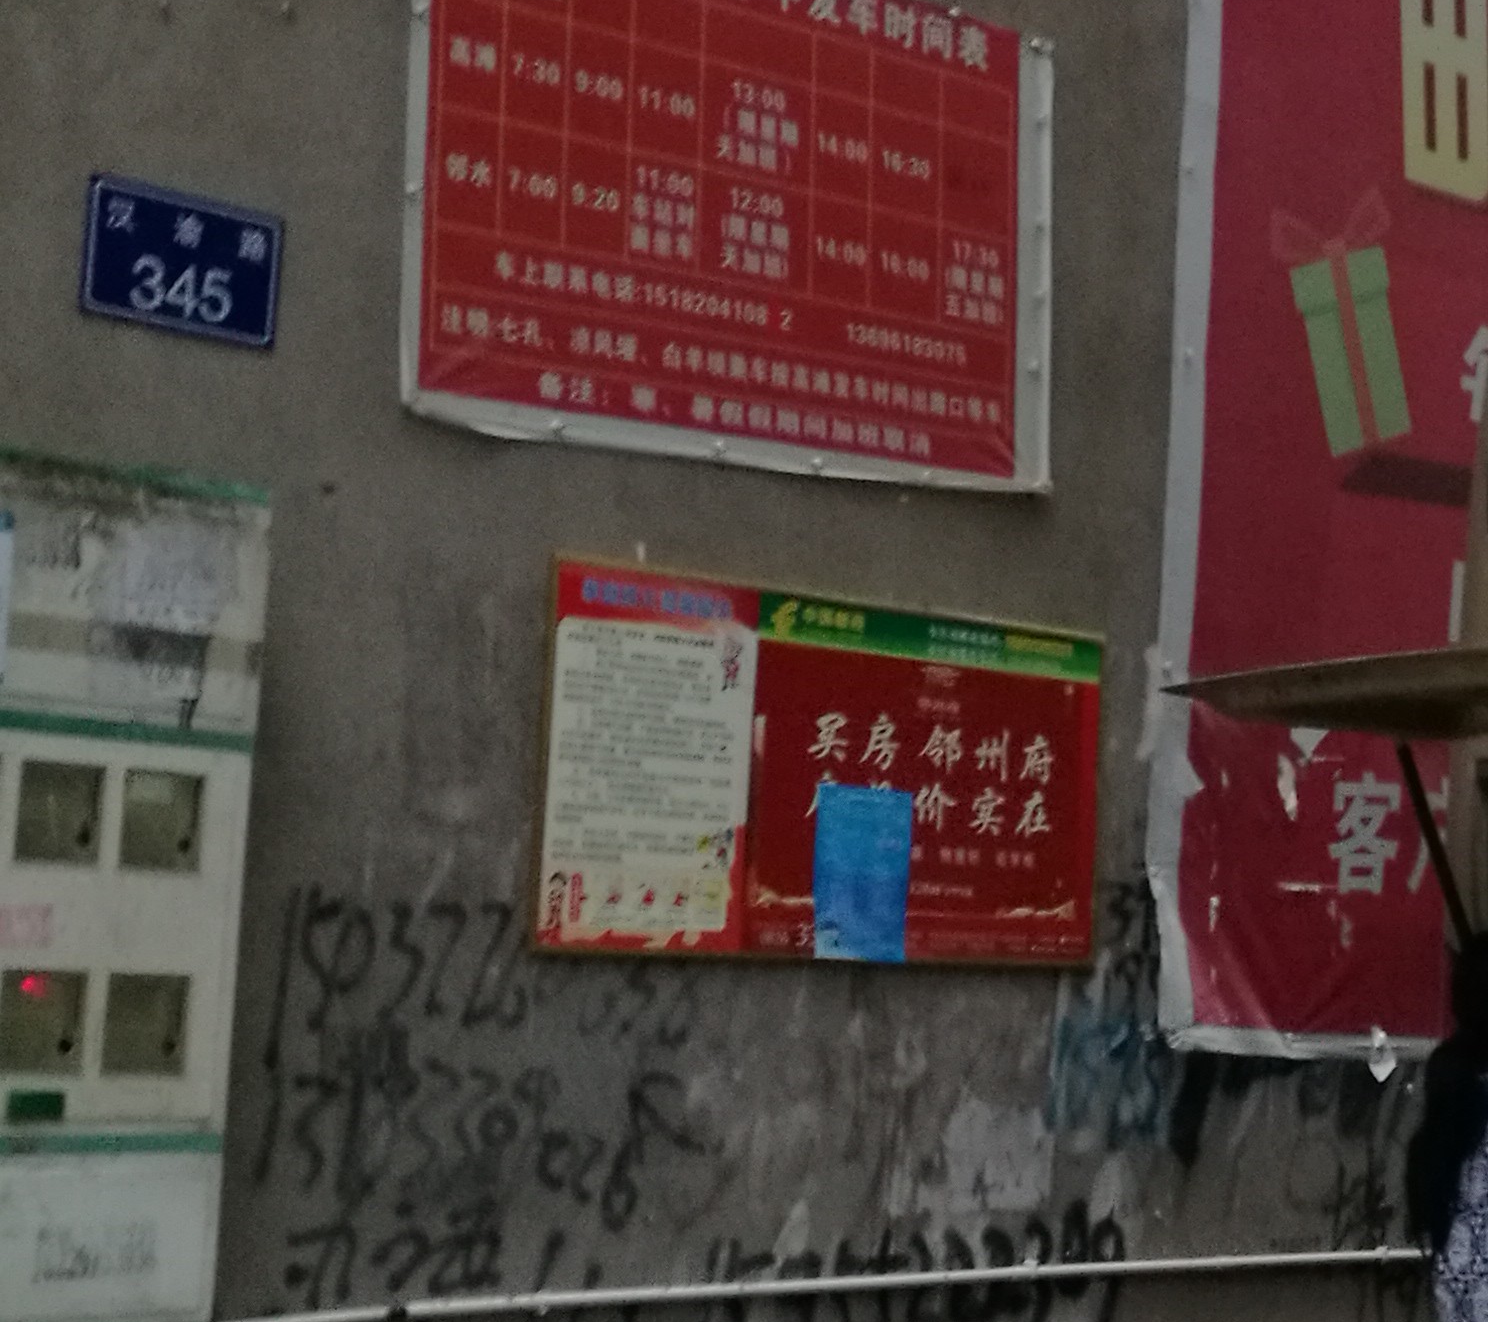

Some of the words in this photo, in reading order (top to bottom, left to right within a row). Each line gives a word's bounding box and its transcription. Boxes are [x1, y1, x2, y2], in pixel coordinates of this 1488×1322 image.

[511, 51, 563, 89] 7:30
[574, 67, 626, 104] 9:00
[637, 83, 698, 121] 11:00
[816, 130, 868, 165] 14:00
[730, 77, 788, 113] 13:00
[635, 163, 695, 199] 11:00
[729, 185, 785, 220] 12:00
[446, 152, 494, 189] 邻水
[507, 164, 559, 200] 7:00
[571, 180, 622, 215] 9:20
[815, 234, 868, 269] 14:00
[129, 252, 234, 325] 345
